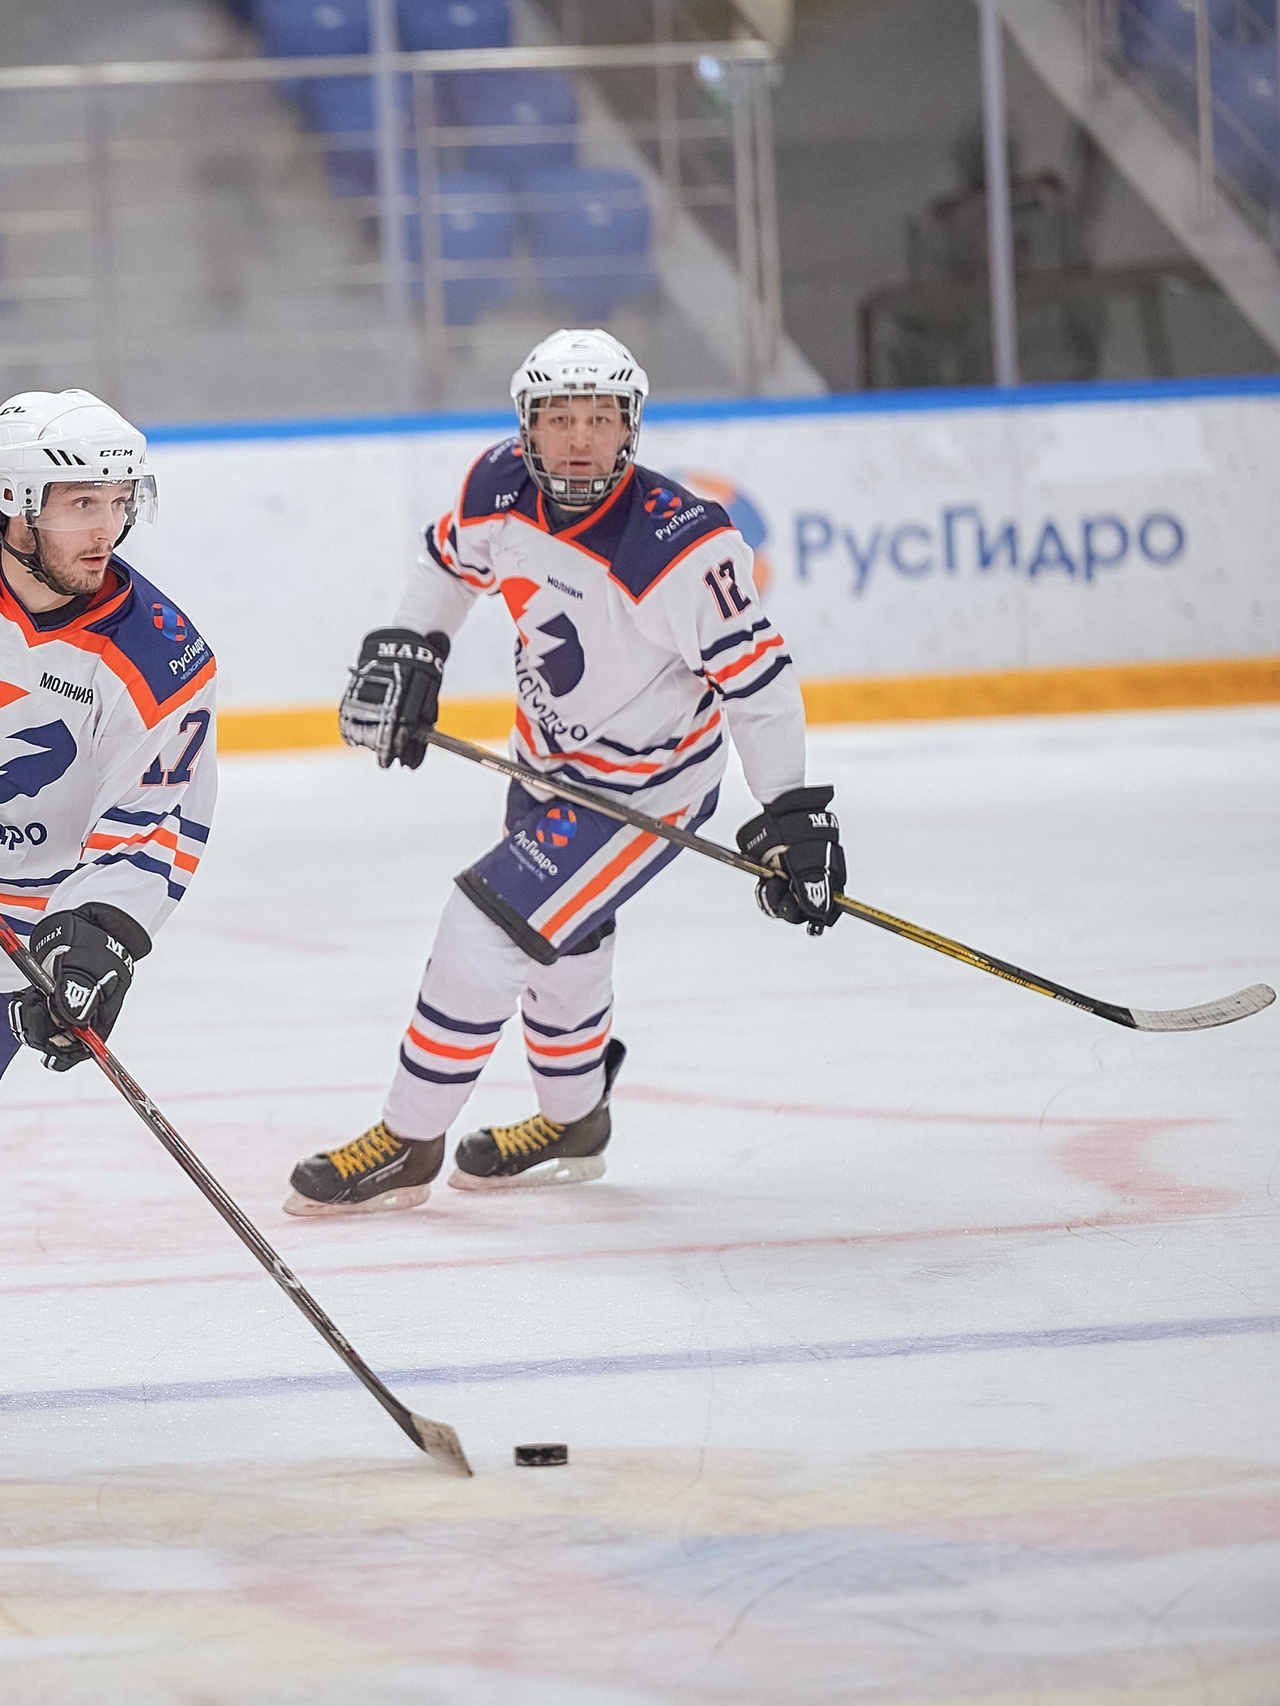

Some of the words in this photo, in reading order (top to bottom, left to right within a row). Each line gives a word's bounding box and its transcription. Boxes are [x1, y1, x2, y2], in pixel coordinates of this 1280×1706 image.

[99, 449, 133, 458] CCM
[655, 504, 706, 541] РусГидро
[795, 505, 1186, 598] РусГидро
[547, 574, 584, 600] МОЛНИЯ
[702, 557, 753, 622] 12
[168, 636, 205, 676] РусГидр
[39, 671, 94, 706] МОЛНИЯ
